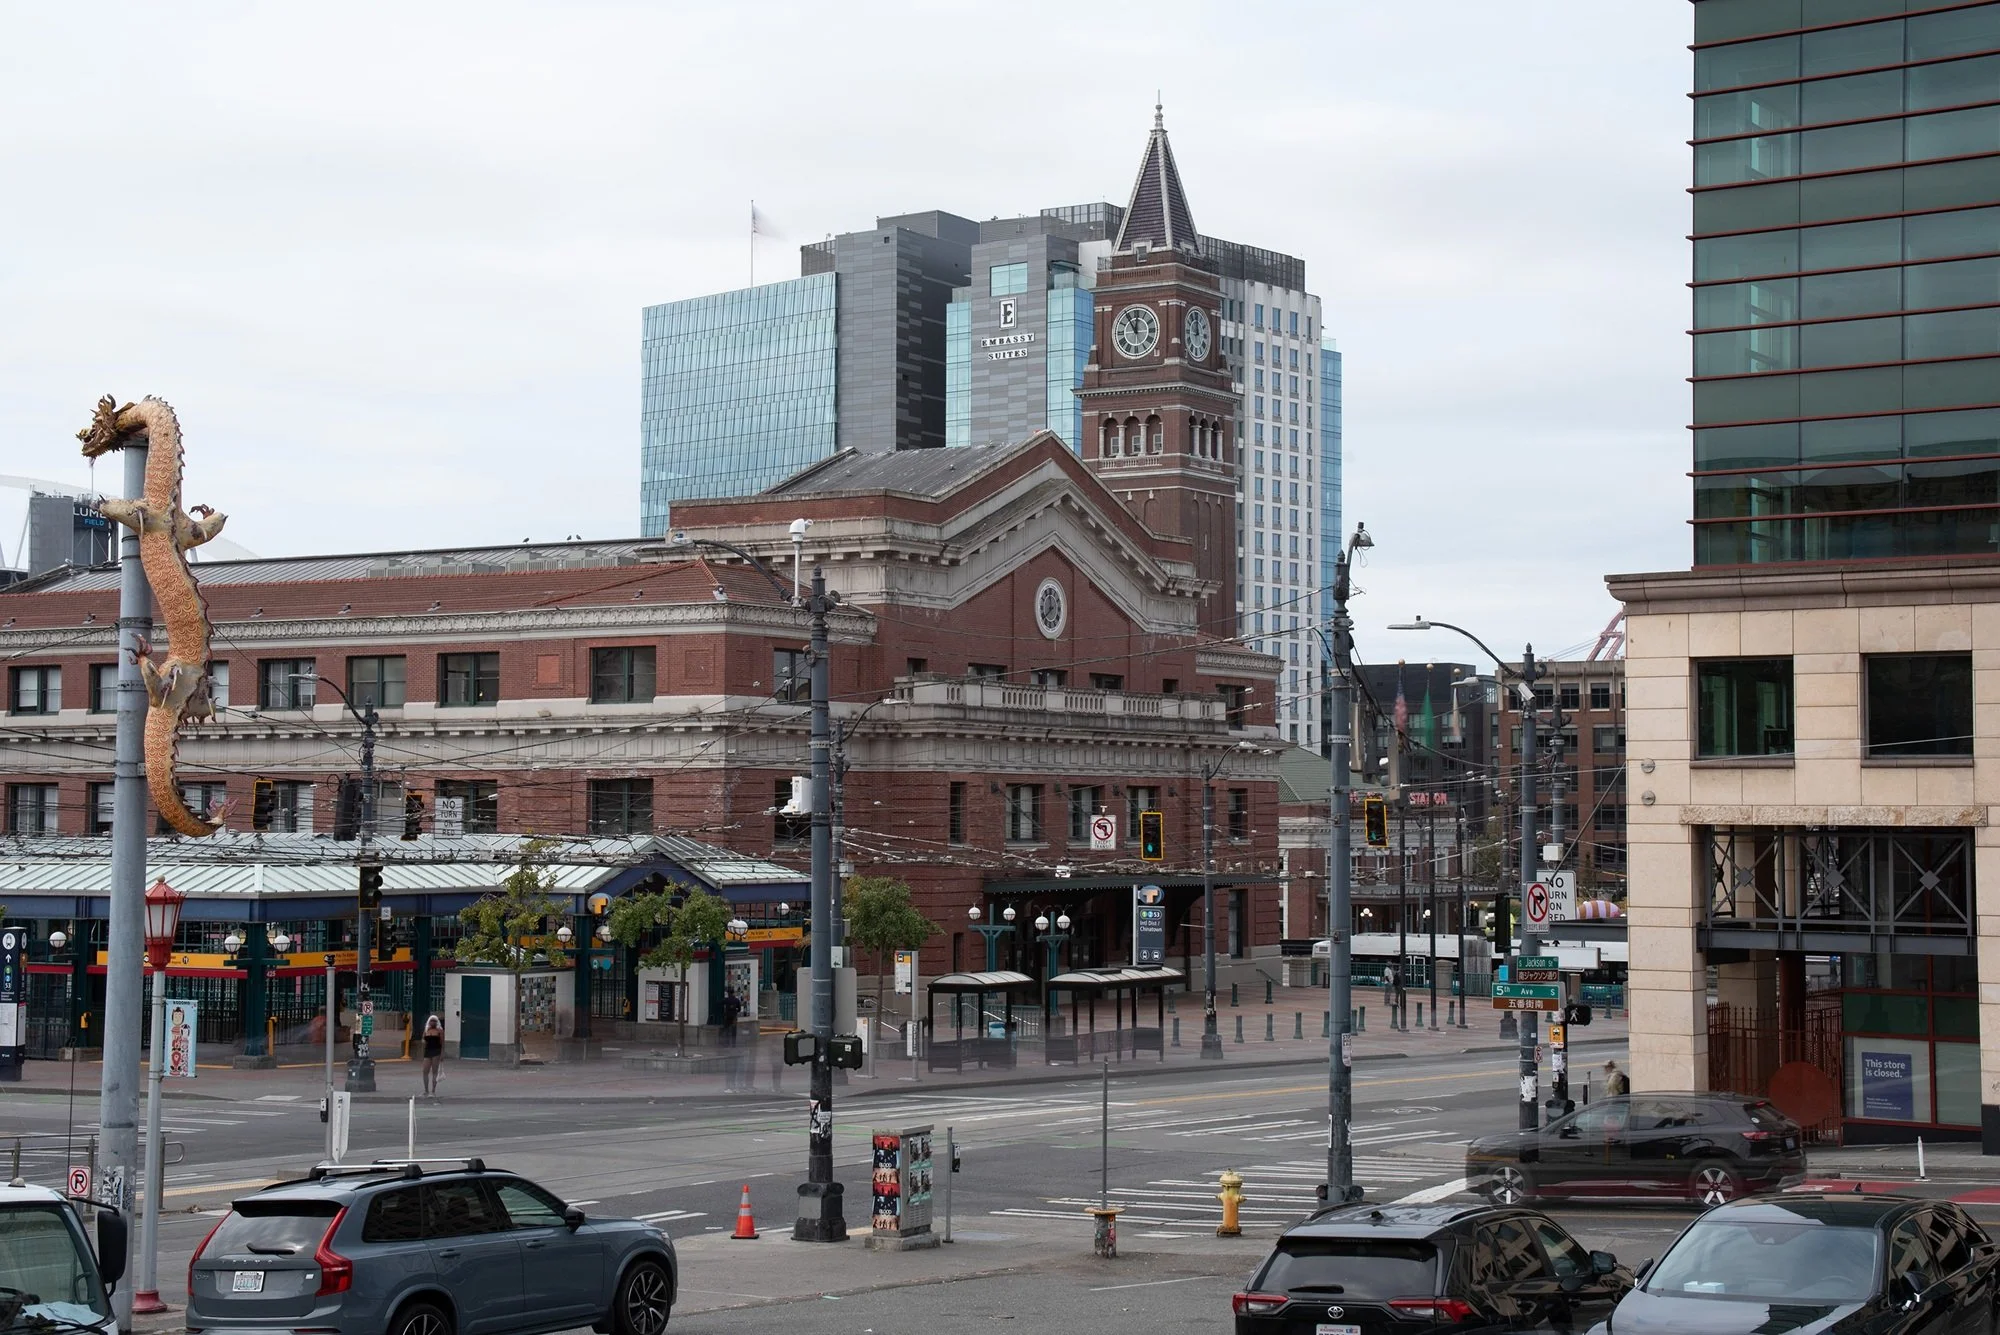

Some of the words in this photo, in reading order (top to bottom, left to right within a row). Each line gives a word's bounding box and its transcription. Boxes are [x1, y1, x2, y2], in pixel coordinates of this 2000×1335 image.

[1002, 303, 1013, 325] E
[982, 334, 1033, 347] EMBASSY
[988, 349, 1027, 360] SUITES
[84, 518, 105, 526] FIELD
[1409, 792, 1448, 805] STATON
[442, 800, 456, 809] NO
[1545, 877, 1564, 888] NO
[1549, 891, 1567, 900] URN
[1549, 902, 1562, 911] ON
[1549, 913, 1566, 921] RED
[1525, 957, 1546, 968] Jackson
[1496, 985, 1511, 996] 5th
[1550, 988, 1556, 996] S
[1865, 1059, 1882, 1068] This
[1884, 1061, 1906, 1069] store
[1865, 1068, 1872, 1076] is
[1873, 1069, 1903, 1078] closed.
